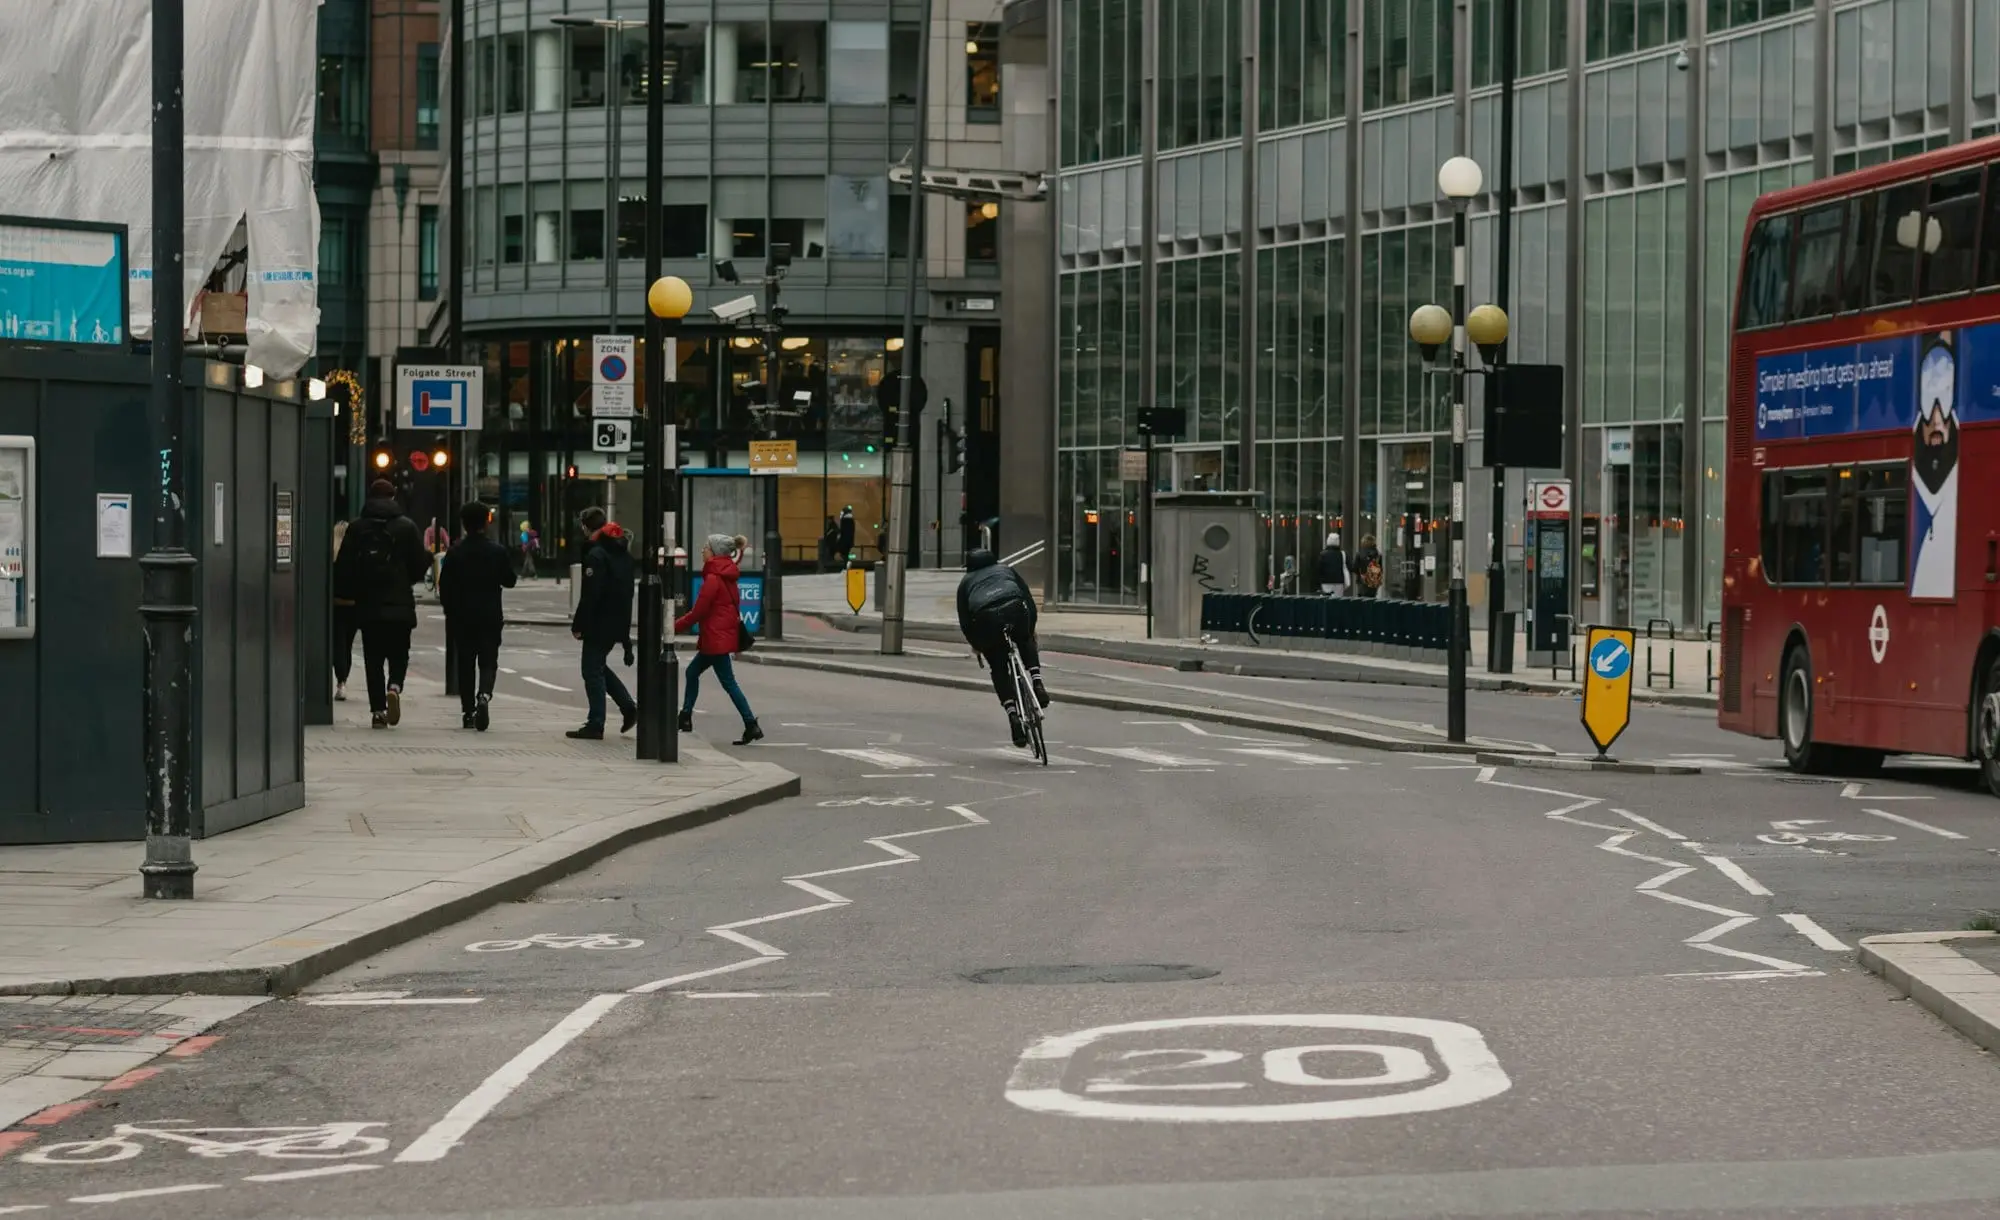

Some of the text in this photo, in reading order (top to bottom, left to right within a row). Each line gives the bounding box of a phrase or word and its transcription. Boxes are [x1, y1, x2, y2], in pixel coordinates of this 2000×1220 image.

[600, 345, 627, 353] ZONE
[403, 368, 477, 378] Folgate Street
[1759, 370, 1786, 396] Simpler
[1787, 364, 1820, 392] investing
[1820, 361, 1836, 385] that
[1836, 363, 1854, 389] gets
[1869, 353, 1894, 379] ahead
[741, 589, 760, 600] ICE
[1085, 1044, 1433, 1092] 20
